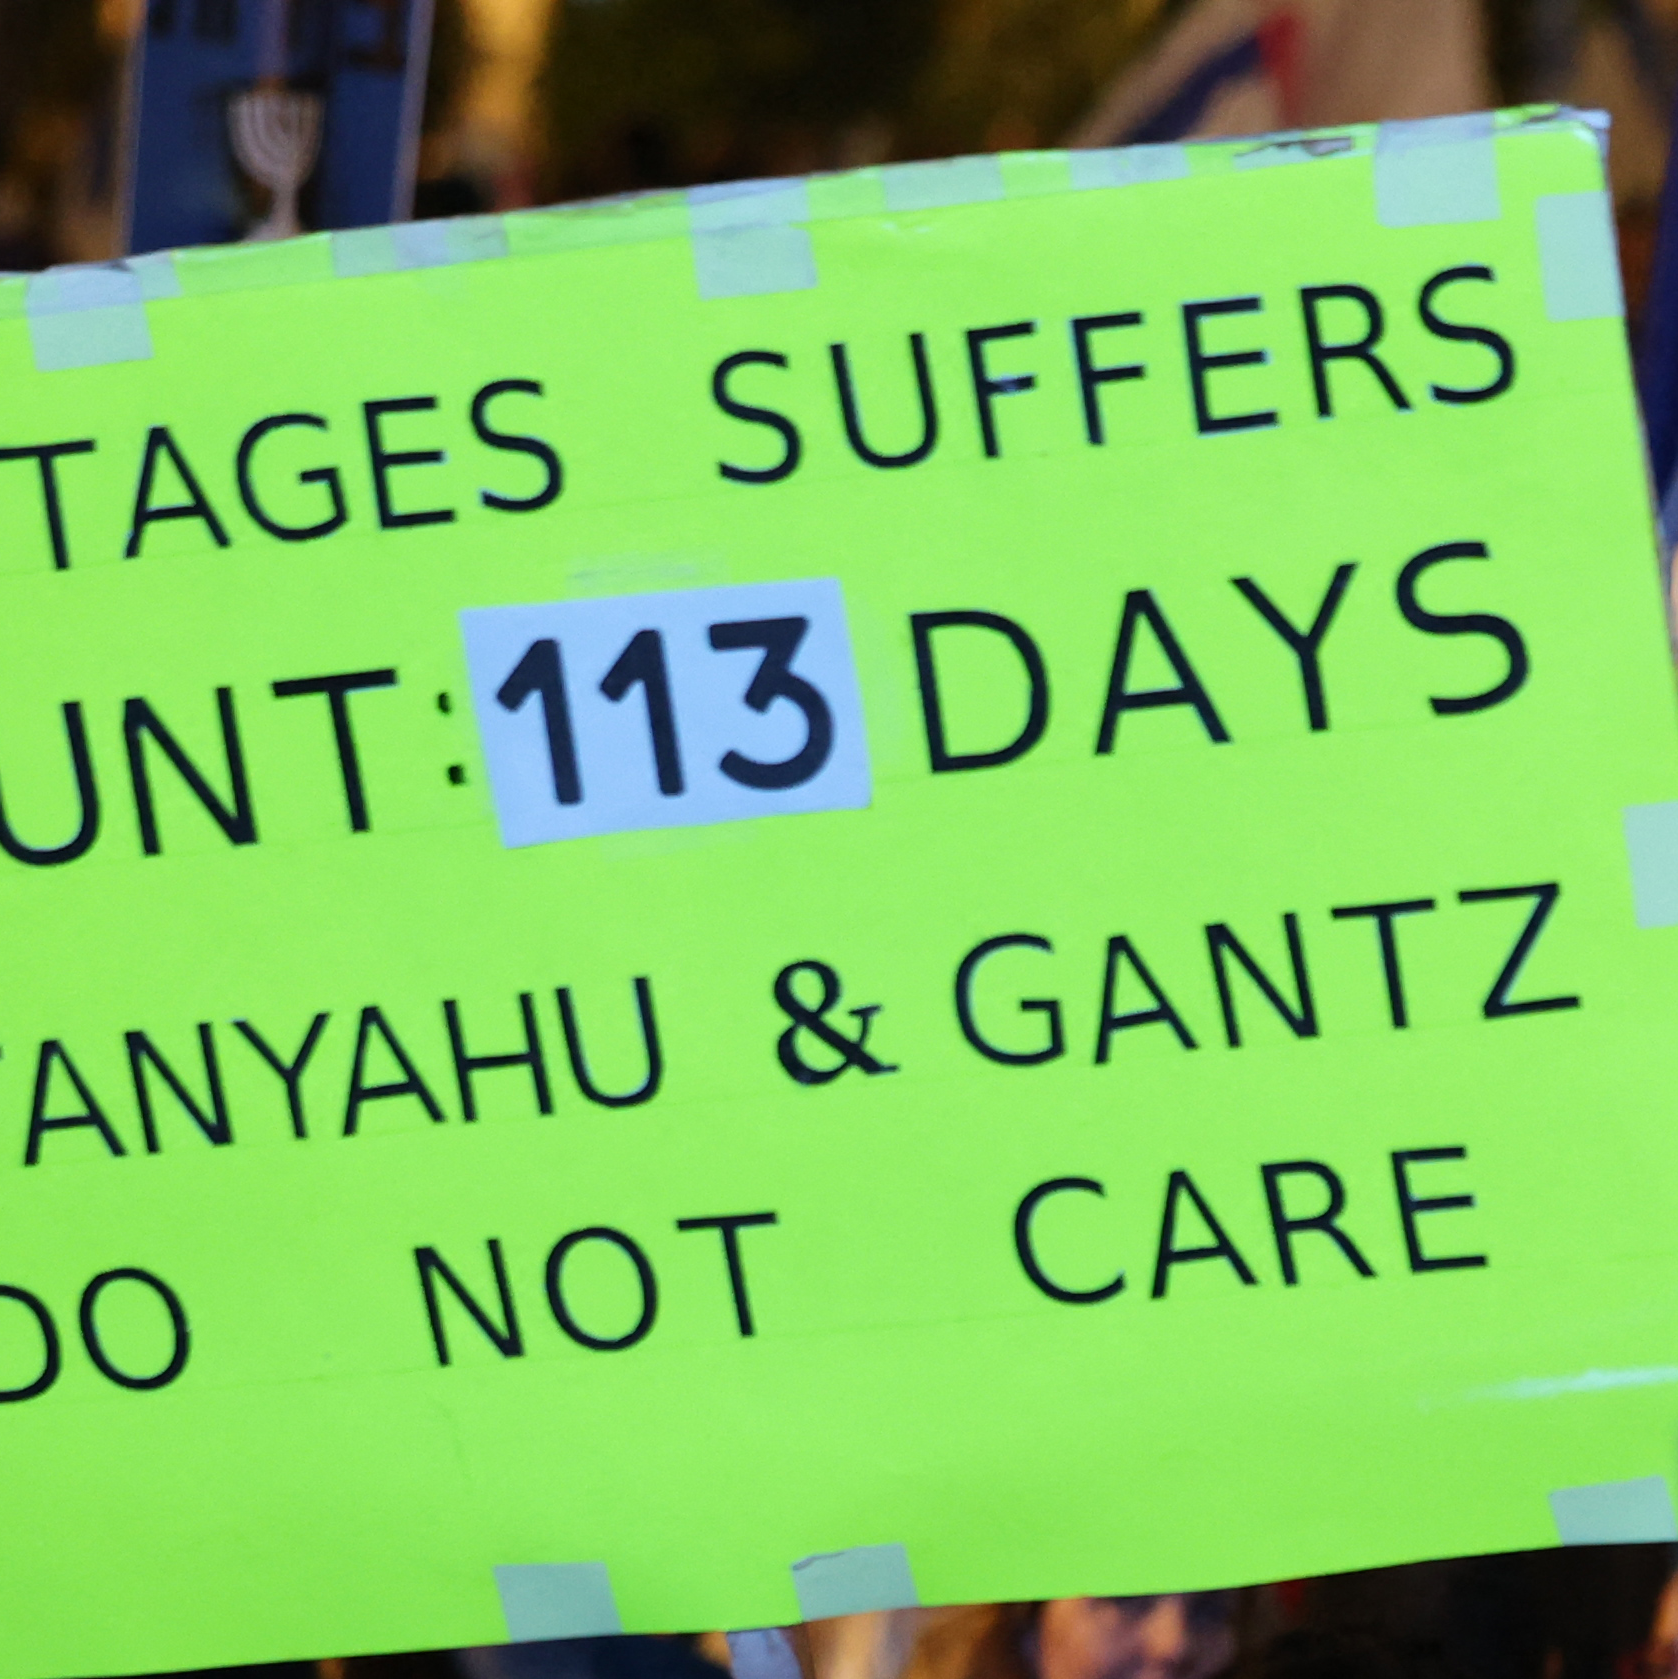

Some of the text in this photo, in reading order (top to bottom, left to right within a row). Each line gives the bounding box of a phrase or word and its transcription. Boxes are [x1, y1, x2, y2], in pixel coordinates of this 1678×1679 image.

[713, 264, 1517, 486] SUFFERS
[496, 615, 836, 807] 113
[908, 540, 1531, 775] DAYS
[772, 959, 900, 1088] &
[953, 882, 1581, 1066] GANTZ
[413, 1212, 779, 1367] NOT
[1013, 1146, 1489, 1305] CARE
